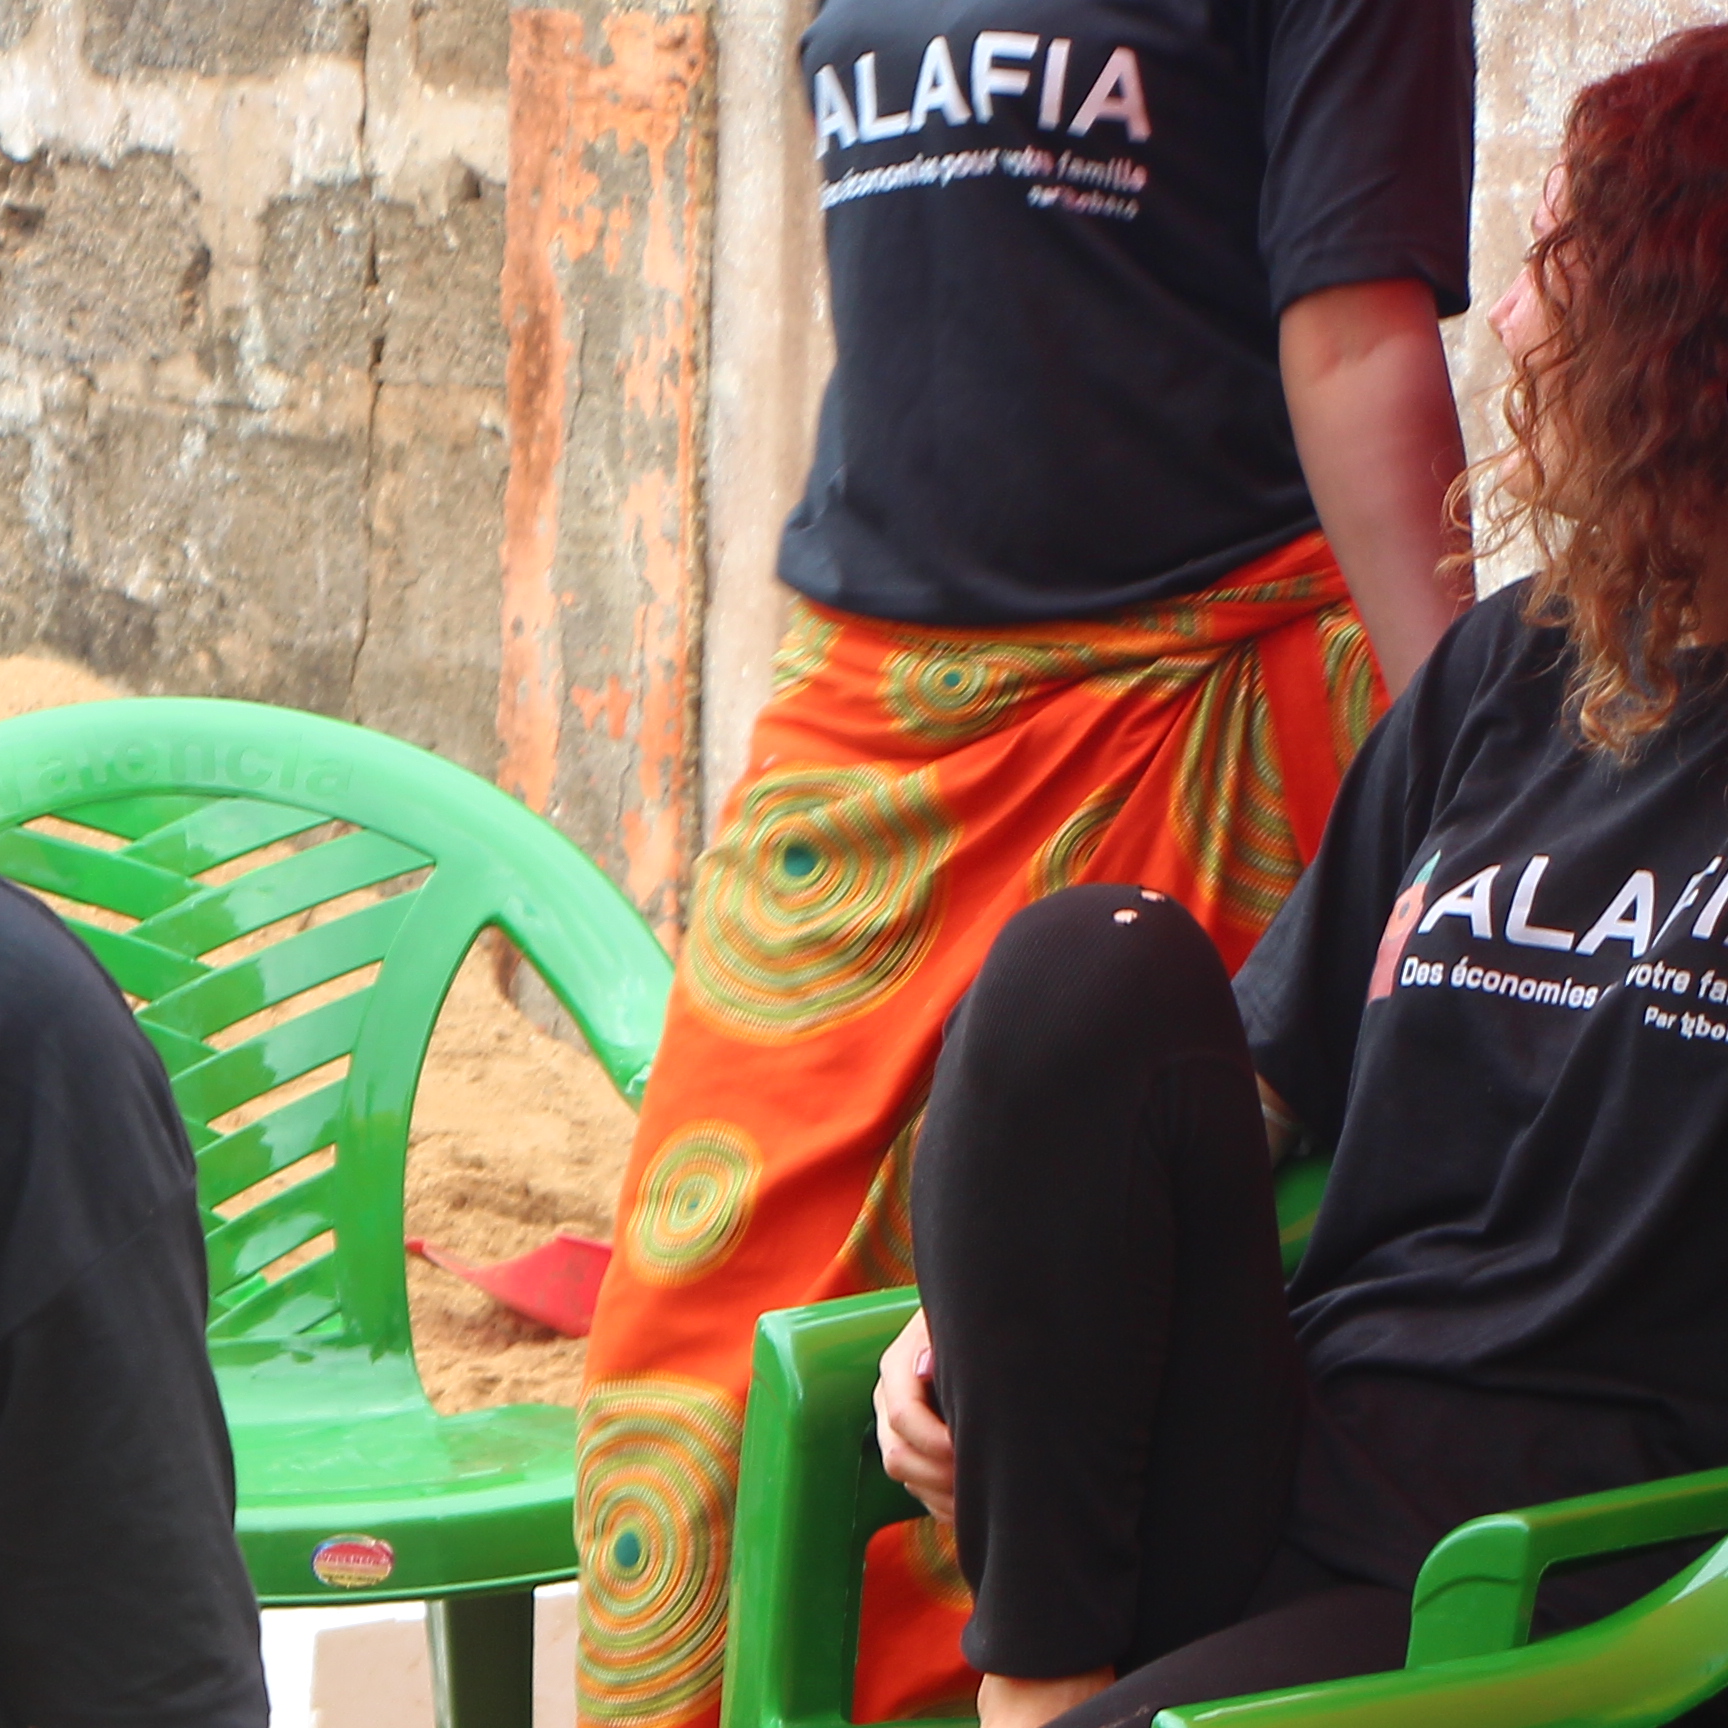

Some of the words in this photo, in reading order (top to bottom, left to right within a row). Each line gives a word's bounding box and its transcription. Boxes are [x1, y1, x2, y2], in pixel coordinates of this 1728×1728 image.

[814, 30, 1152, 162] ALAFIA
[1400, 955, 1444, 988] Des
[1449, 955, 1600, 1010] économies
[1644, 1005, 1678, 1030] Par
